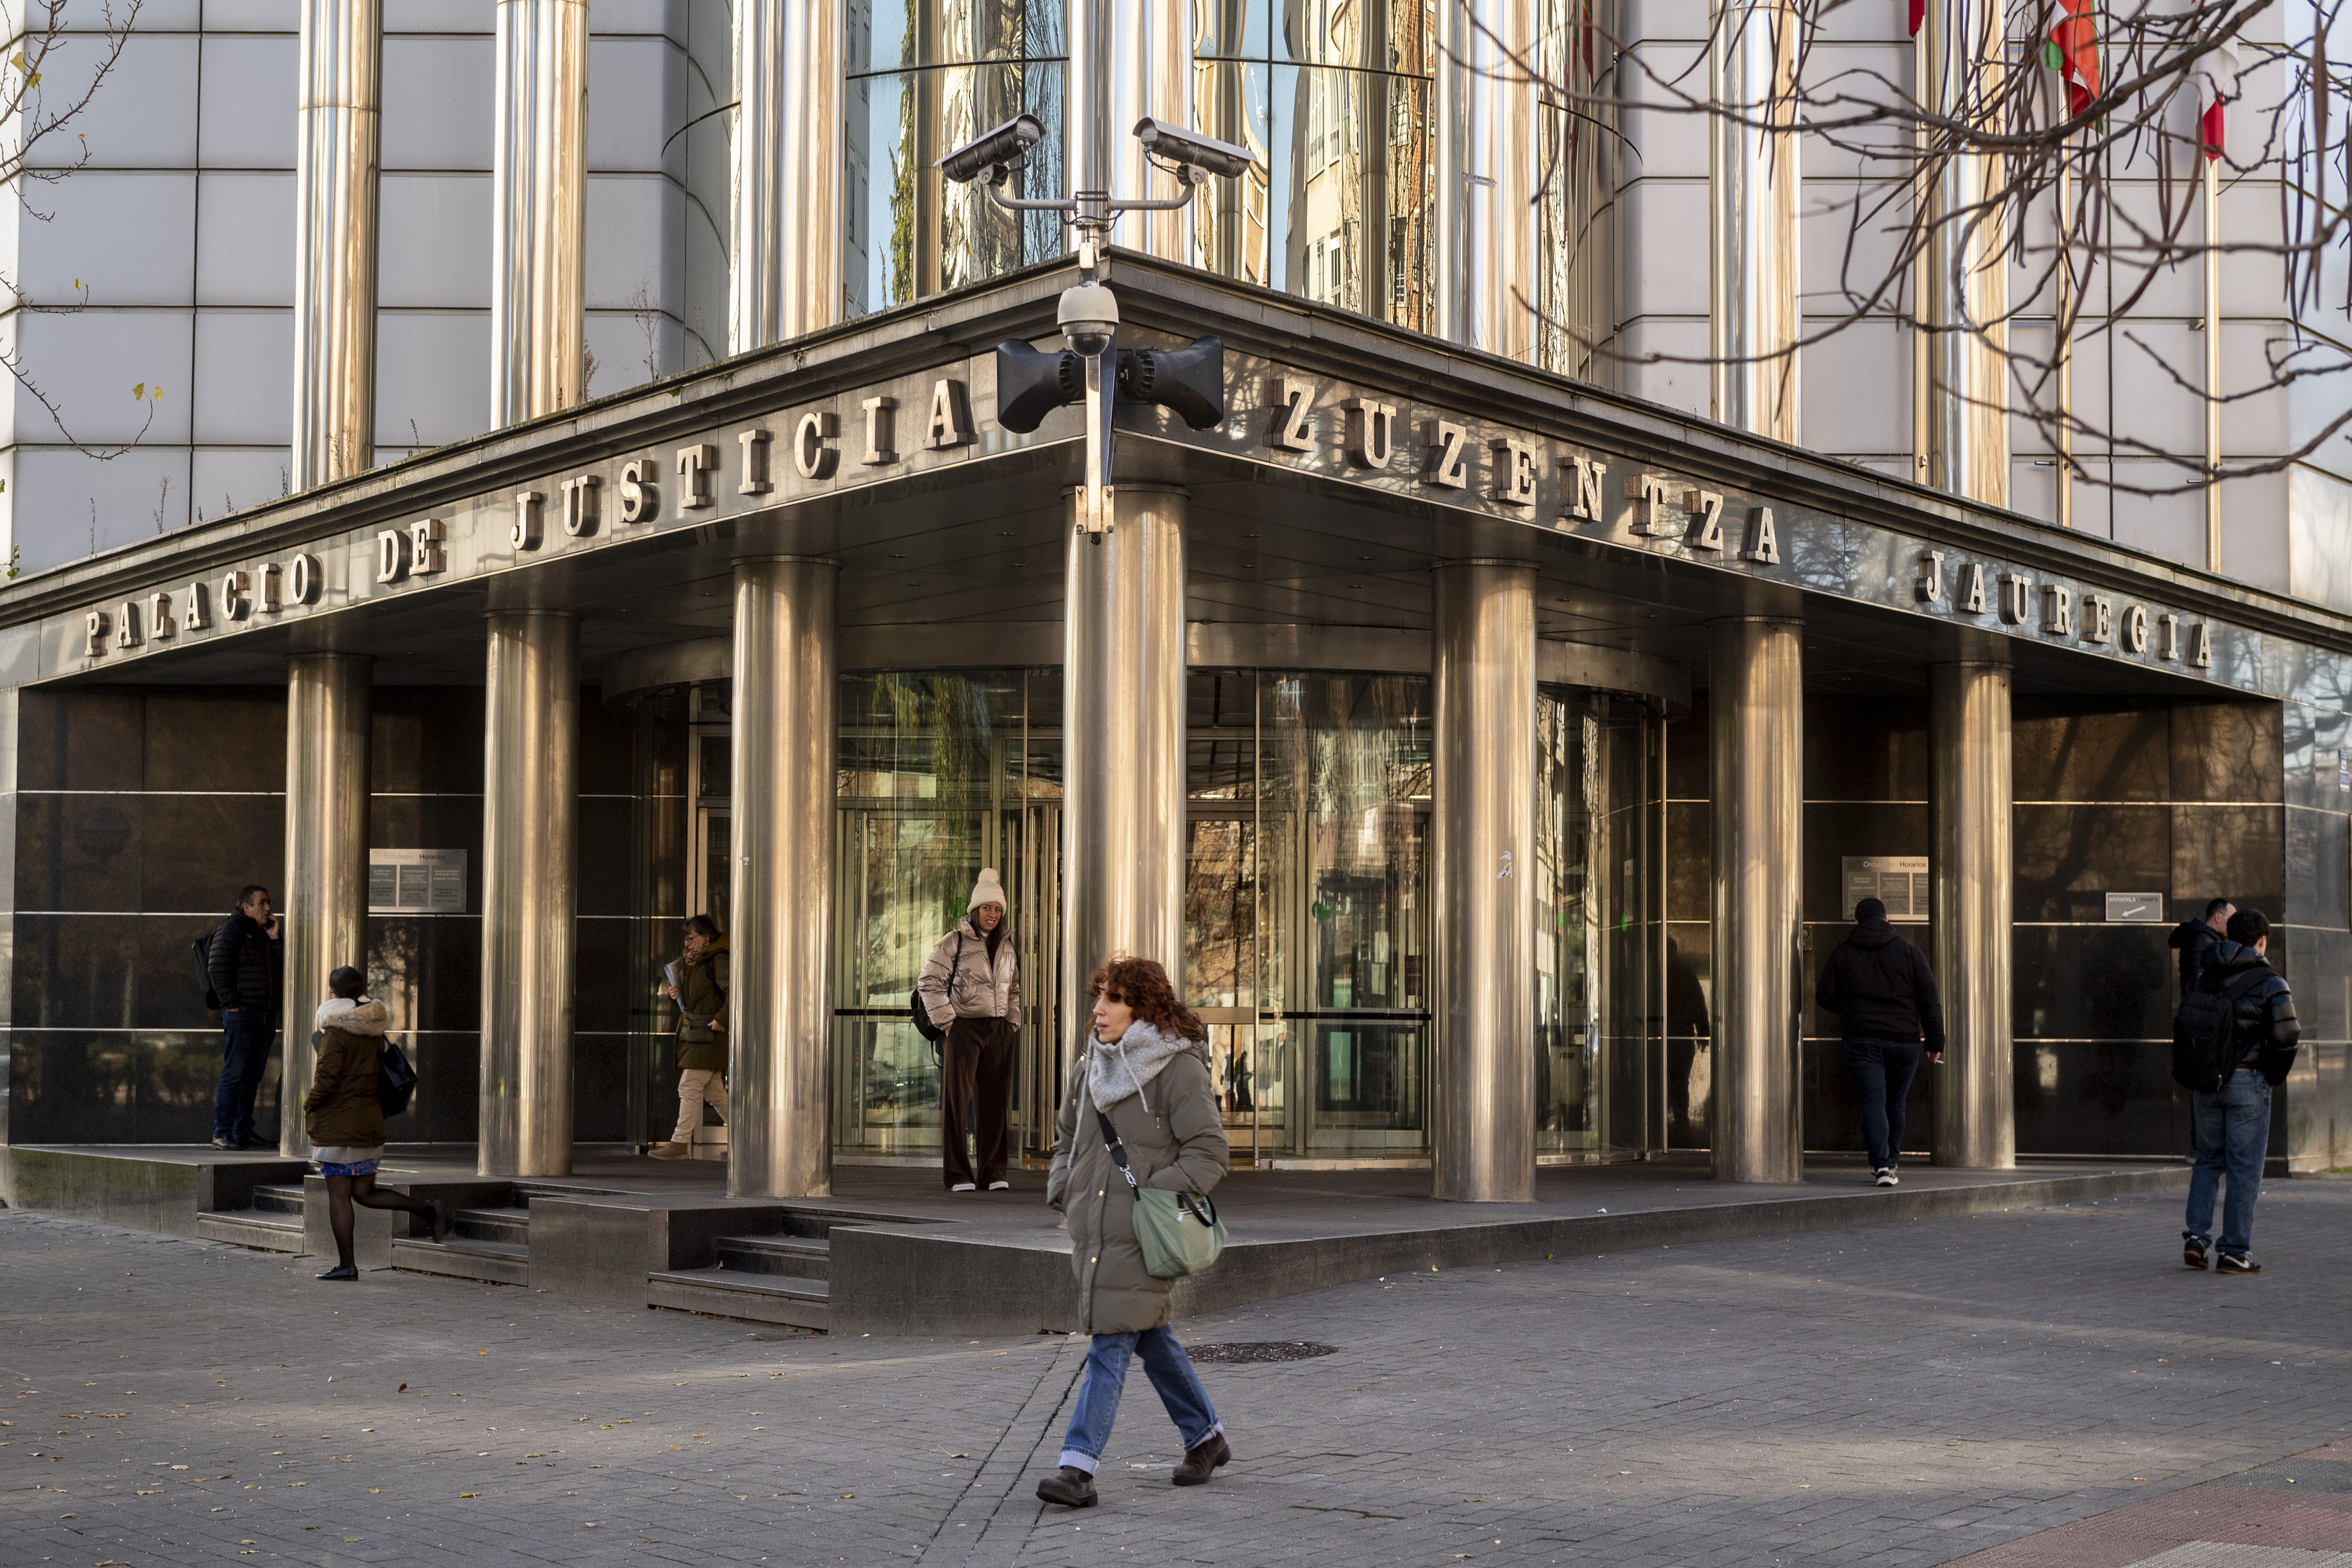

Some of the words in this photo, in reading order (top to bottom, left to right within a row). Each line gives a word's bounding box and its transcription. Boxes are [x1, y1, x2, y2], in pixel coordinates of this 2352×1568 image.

[85, 553, 321, 657] PALACIO
[377, 518, 447, 584] DE
[510, 378, 971, 551] JUSTICIA
[1264, 378, 1780, 565] ZUZENTZA
[1915, 550, 2212, 669] JAUREGIA
